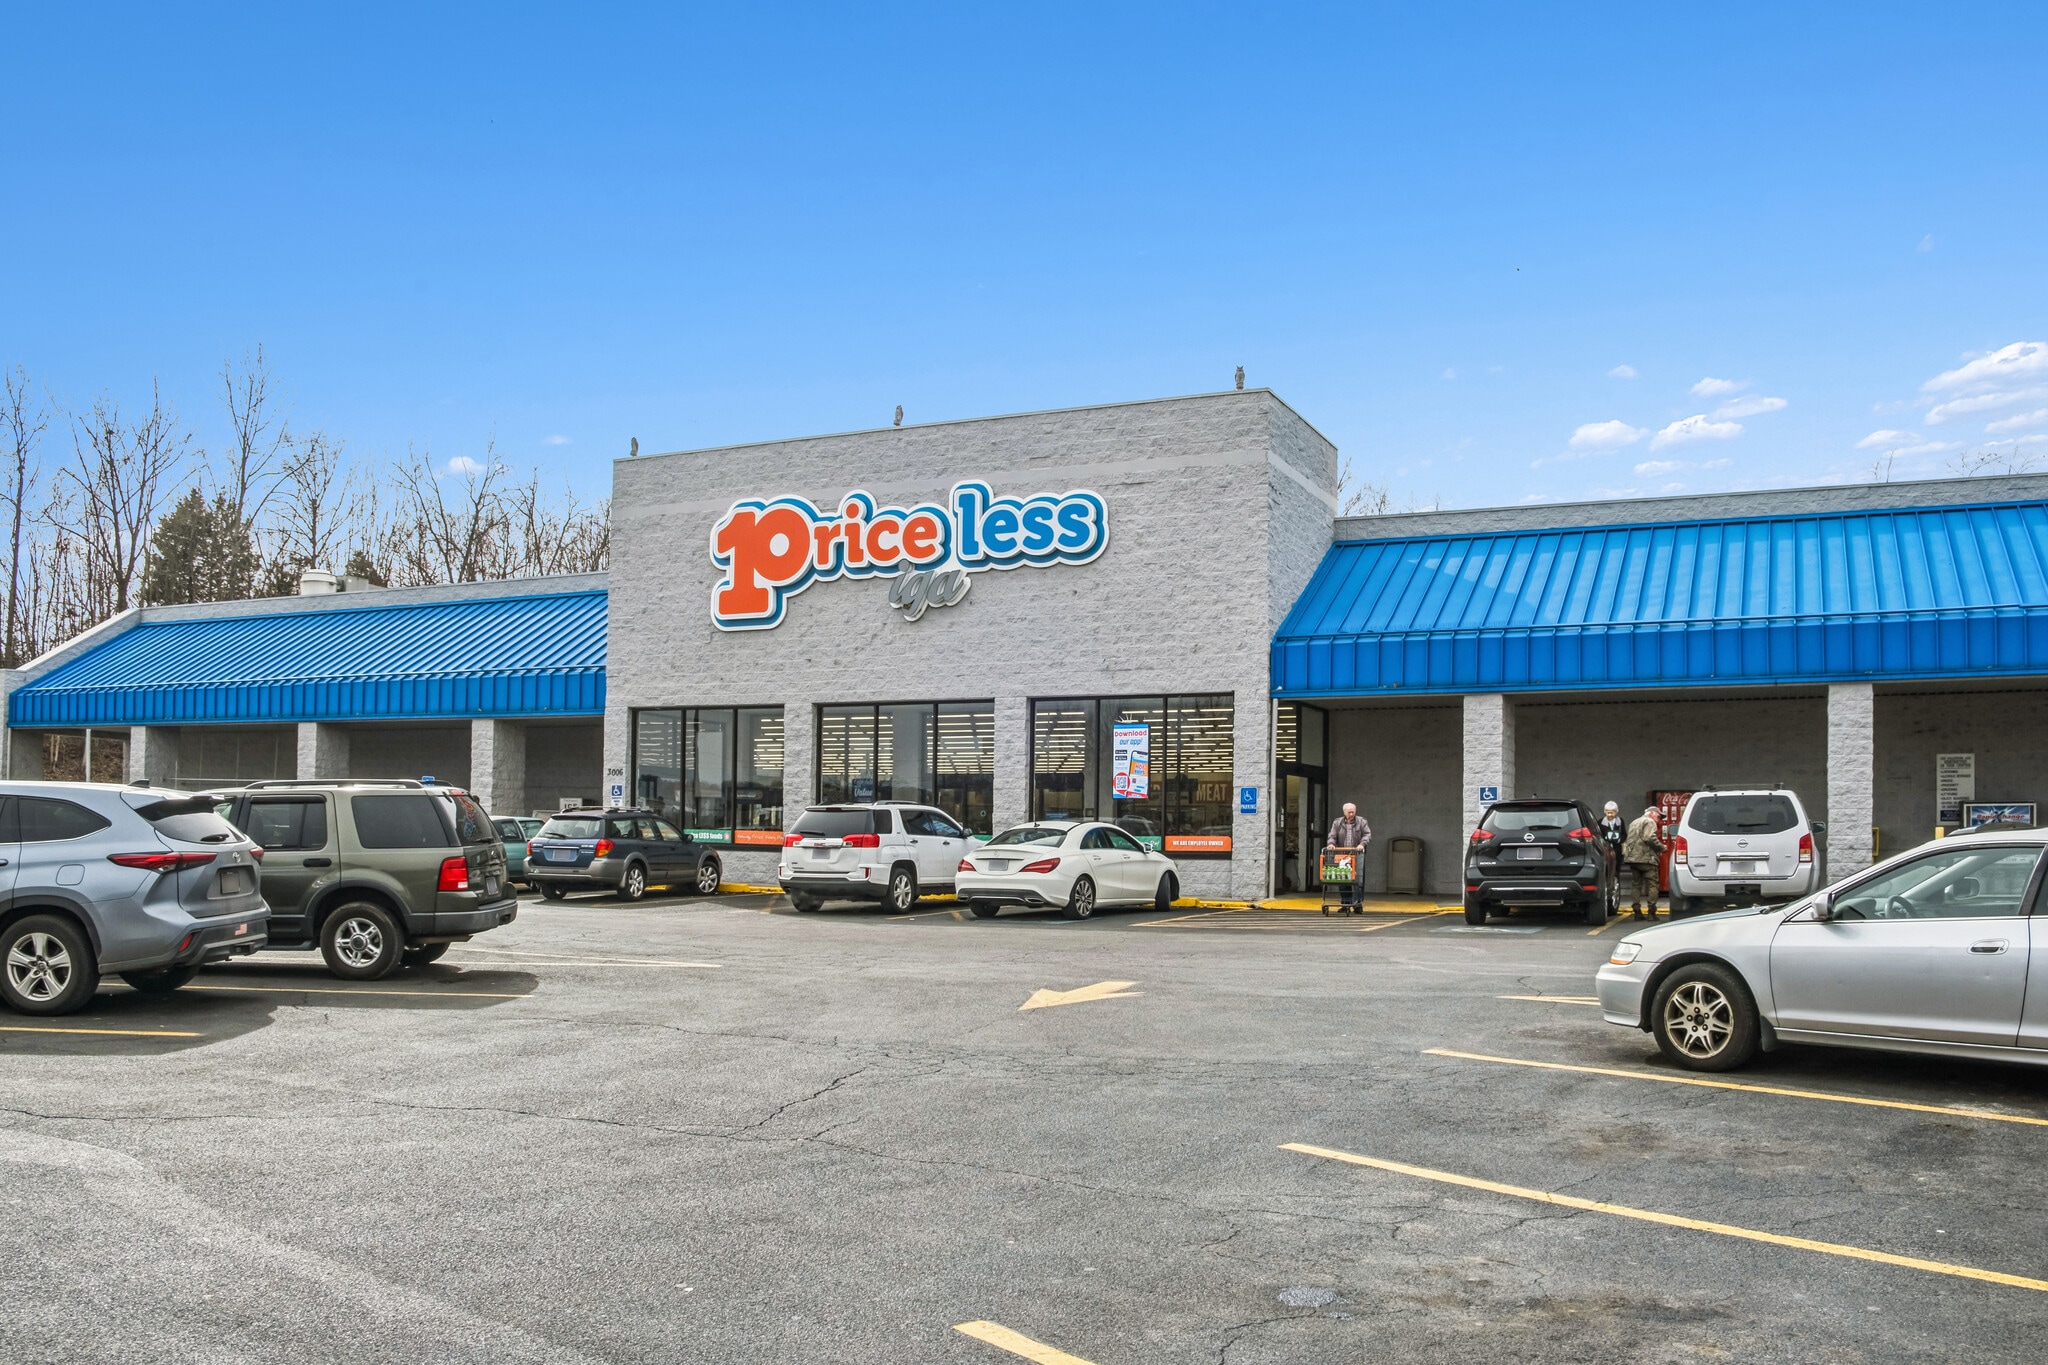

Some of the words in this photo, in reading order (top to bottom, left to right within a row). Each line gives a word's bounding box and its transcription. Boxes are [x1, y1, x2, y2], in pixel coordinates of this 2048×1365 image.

[957, 492, 1092, 557] less
[888, 559, 969, 618] iga
[607, 768, 624, 776] 3006
[1196, 783, 1228, 801] MEAT
